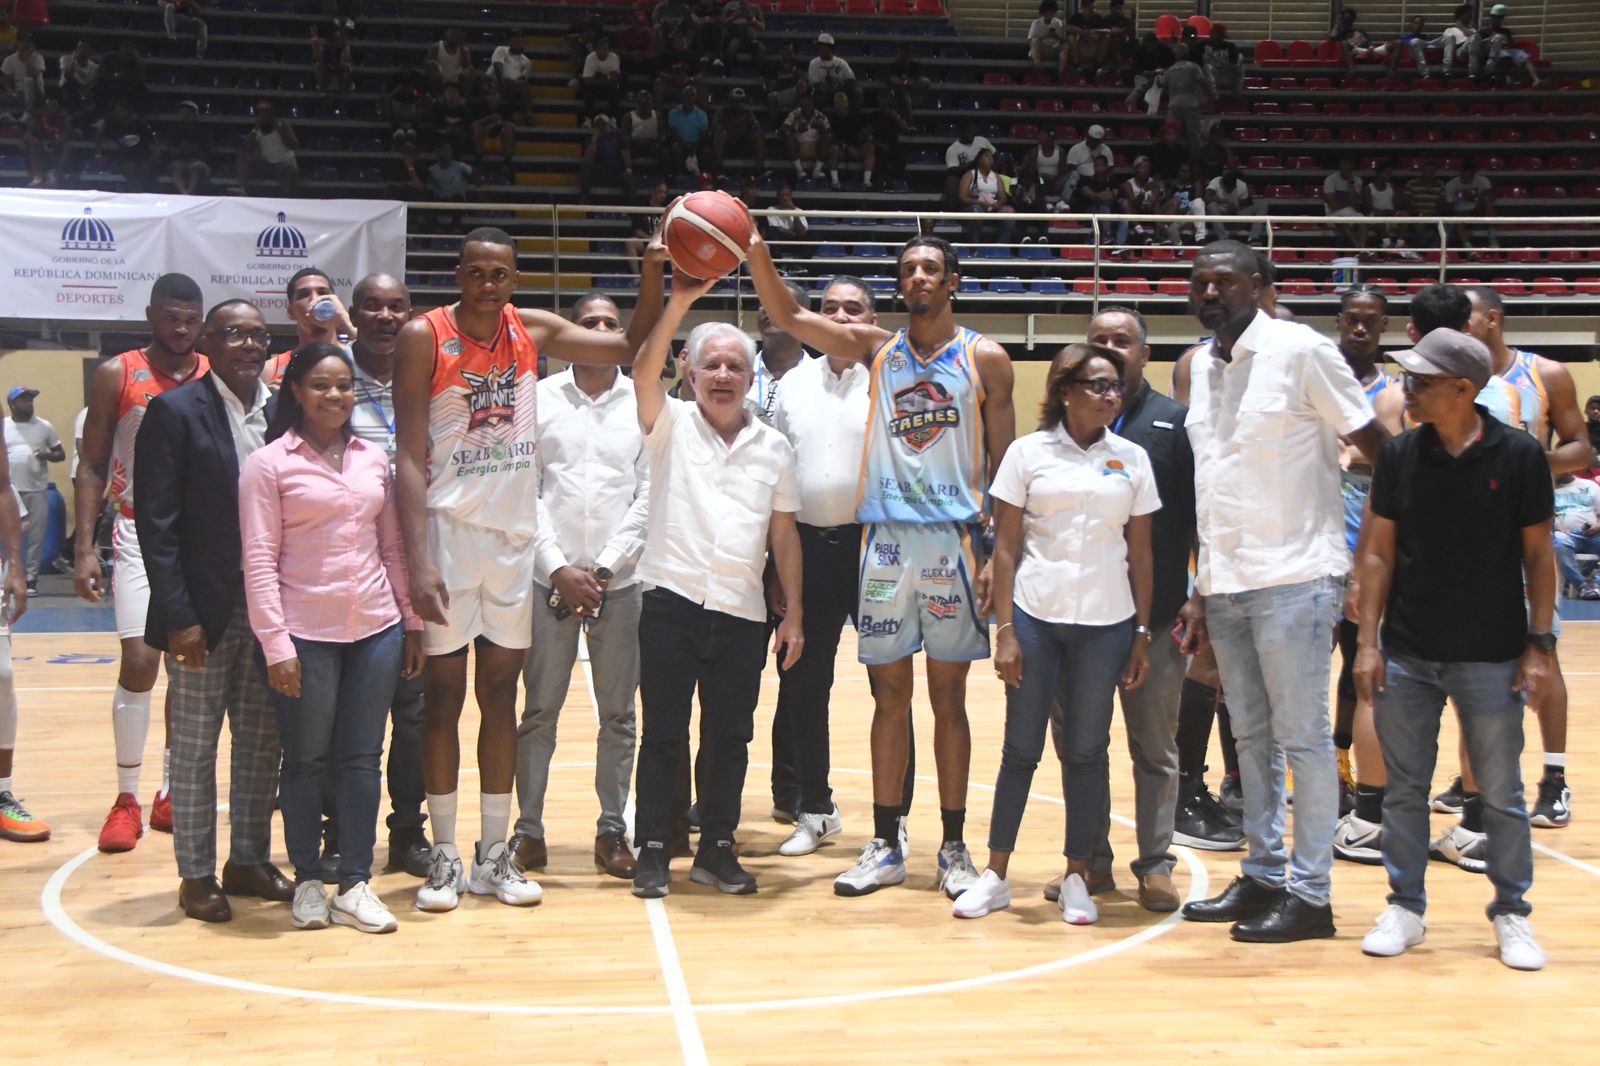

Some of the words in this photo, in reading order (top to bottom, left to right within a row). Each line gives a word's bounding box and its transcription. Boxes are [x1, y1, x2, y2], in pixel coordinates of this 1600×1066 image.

[52, 256, 98, 265] GOBIERNO
[100, 257, 112, 265] DE
[114, 257, 126, 265] LA
[246, 262, 291, 271] GOBIERNO
[14, 266, 81, 280] REPÚBLICA
[85, 270, 162, 281] DOMINICANA
[210, 273, 274, 286] REPÚBLICA
[56, 293, 125, 305] DEPORTES
[889, 409, 957, 433] TRENES
[450, 440, 535, 466] SEABOARD
[879, 477, 960, 497] SEABOARD
[860, 614, 904, 635] Betty
